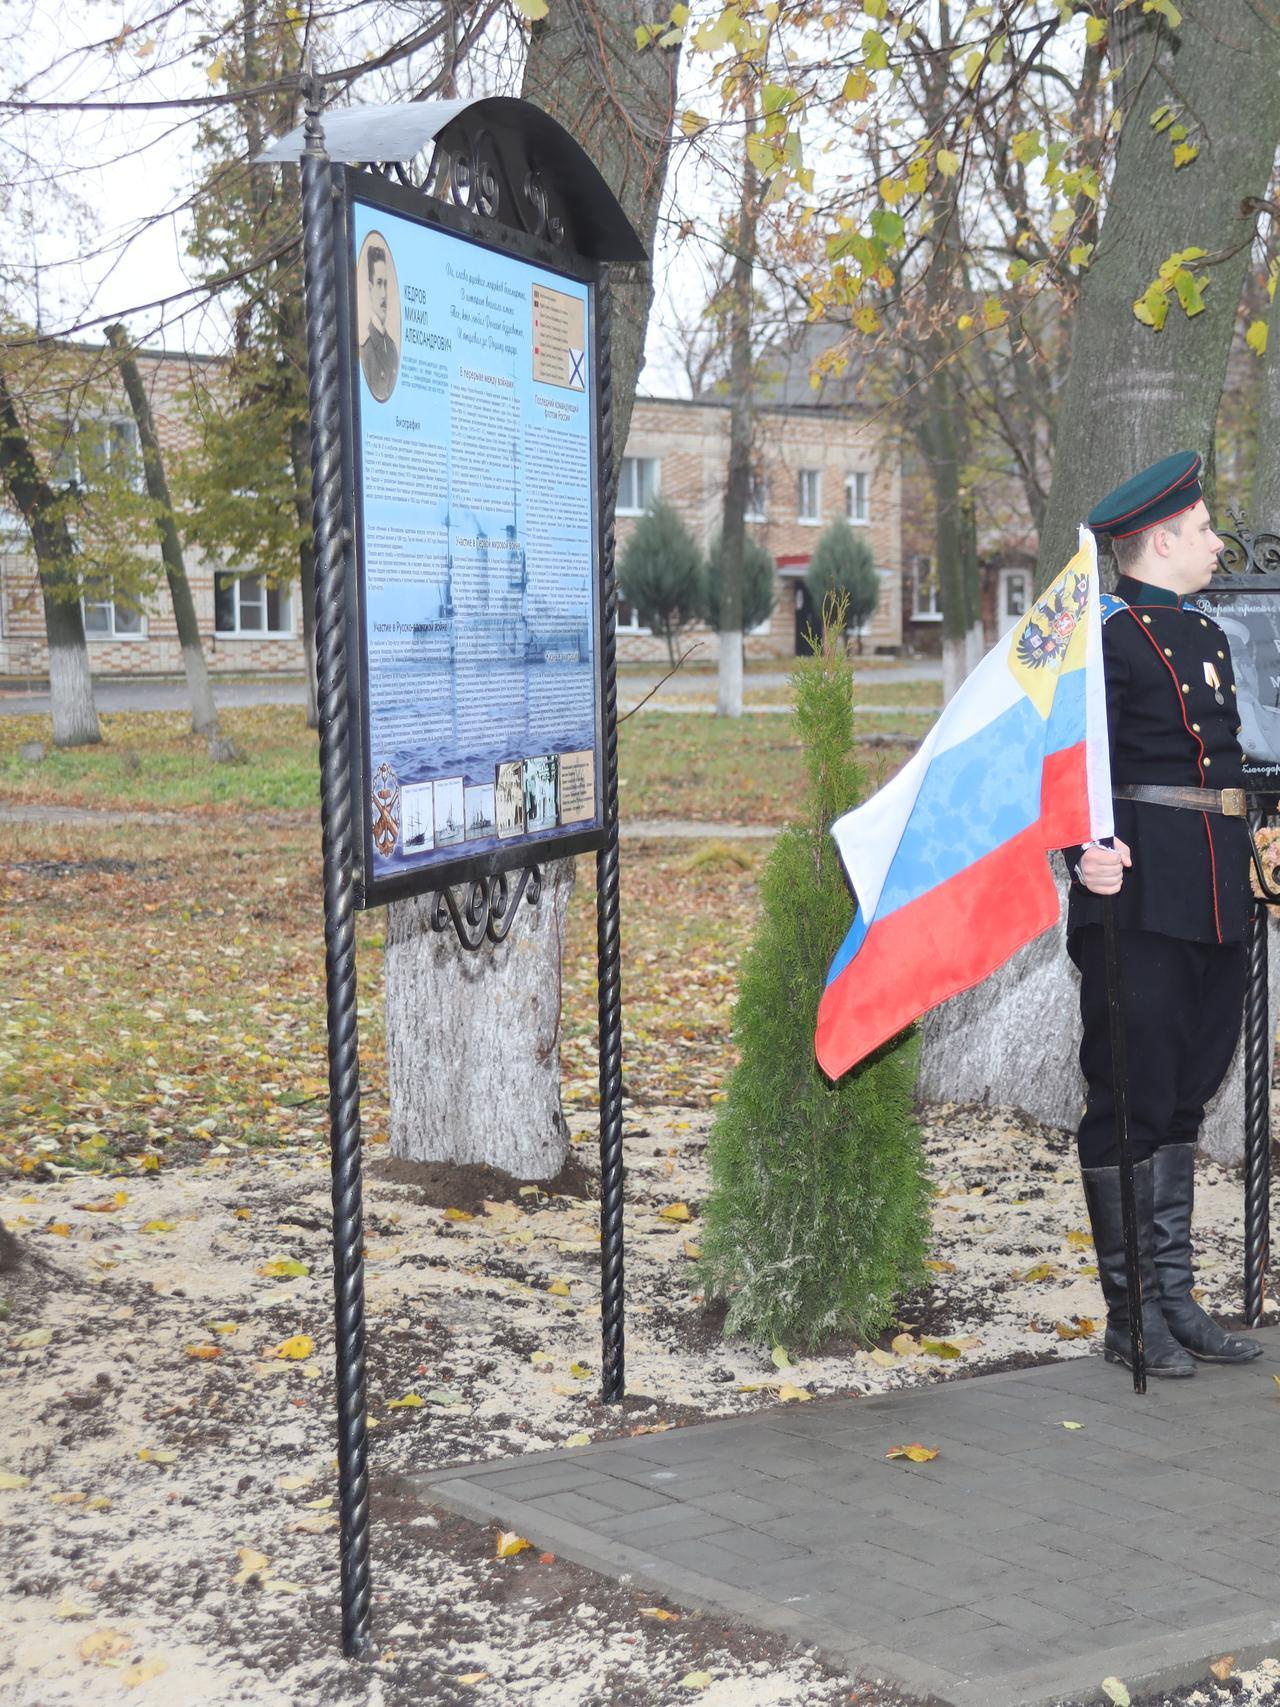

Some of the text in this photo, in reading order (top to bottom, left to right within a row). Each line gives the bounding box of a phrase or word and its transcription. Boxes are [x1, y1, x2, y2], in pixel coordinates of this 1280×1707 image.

[404, 285, 427, 304] КЕДРОВ
[404, 306, 428, 326] МИХАИЛ
[405, 327, 452, 352] АЛЕКСАНДРОВИЧ
[396, 416, 420, 432] Биография
